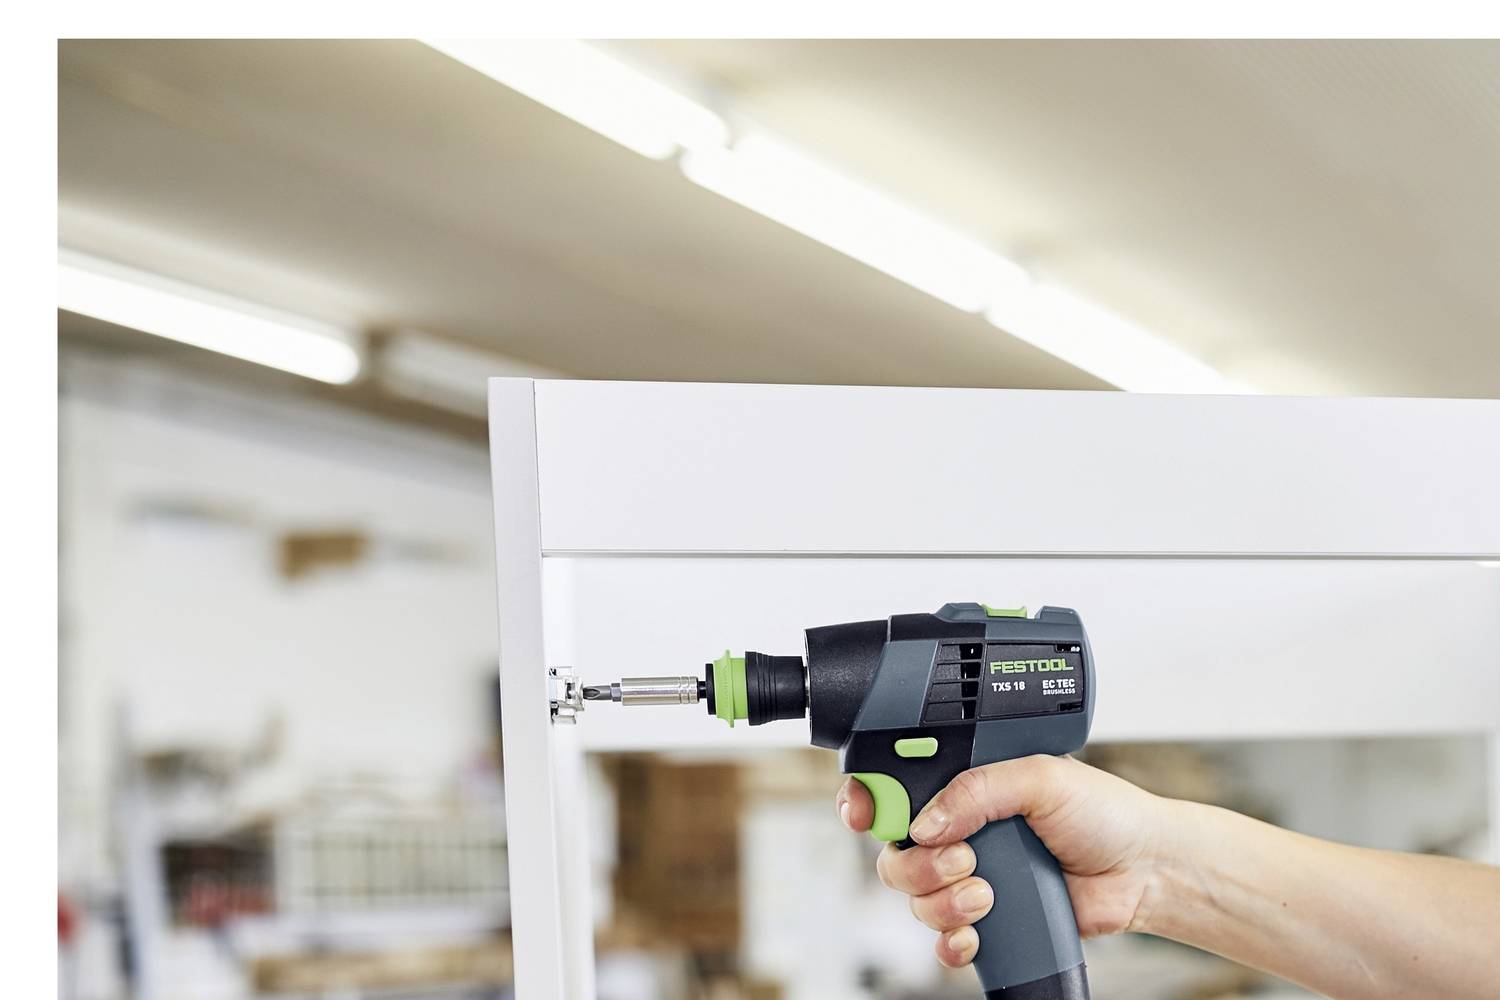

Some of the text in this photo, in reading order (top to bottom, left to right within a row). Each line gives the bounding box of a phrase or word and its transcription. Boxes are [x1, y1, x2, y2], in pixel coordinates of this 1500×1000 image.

[990, 658, 1074, 674] FESTOOL
[992, 681, 1026, 692] TXS 18
[1042, 678, 1075, 689] EC TEC
